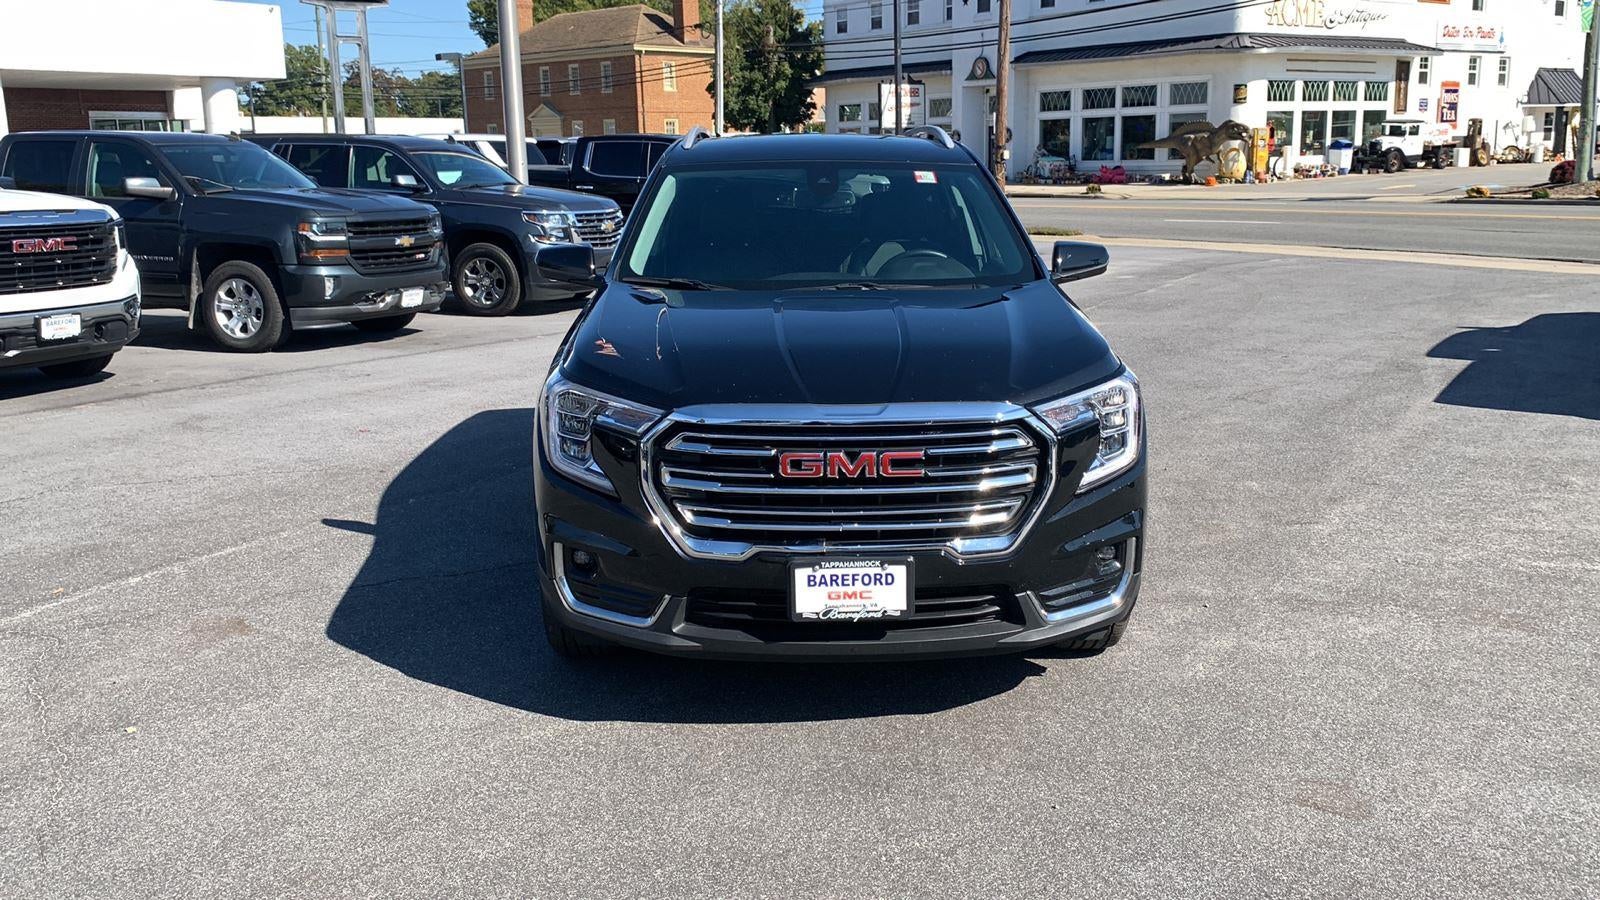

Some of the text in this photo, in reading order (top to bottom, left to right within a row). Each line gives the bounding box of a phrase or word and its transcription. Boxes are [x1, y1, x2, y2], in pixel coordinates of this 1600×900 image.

[1442, 109, 1456, 121] TEA
[12, 236, 78, 254] GMC
[45, 318, 77, 328] BAREFORD
[779, 449, 926, 478] GMC
[821, 560, 881, 569] TAPPAHANNOCK
[807, 572, 895, 588] BAREFORD
[827, 590, 873, 601] GMC
[818, 607, 888, 622] Bareford
